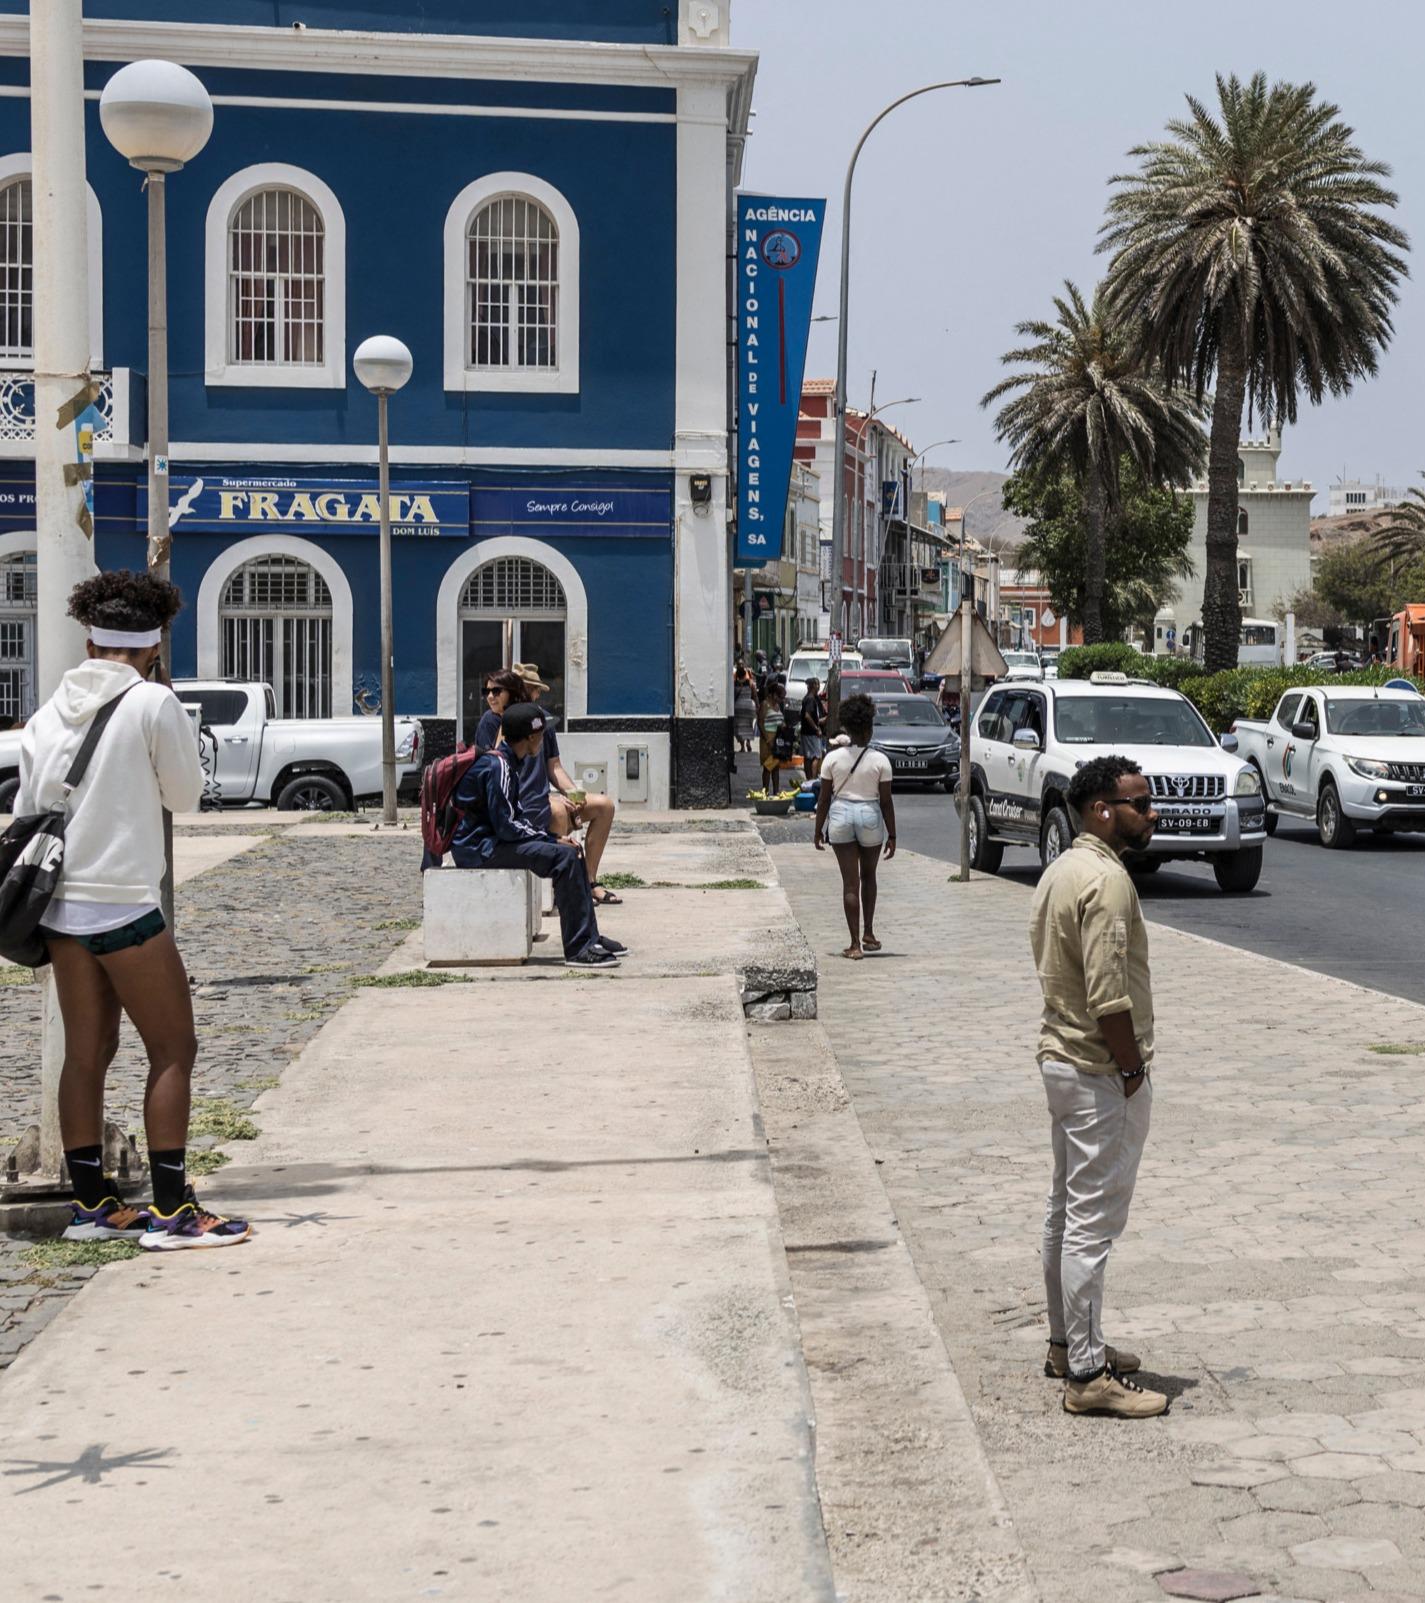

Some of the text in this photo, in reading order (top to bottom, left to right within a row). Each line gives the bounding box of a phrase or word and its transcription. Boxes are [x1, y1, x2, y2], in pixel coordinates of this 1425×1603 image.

[745, 206, 816, 222] AGÊNCIA
[745, 229, 759, 364] NACIONAL
[748, 372, 758, 394] DE
[222, 478, 297, 489] Supermercado
[19, 494, 37, 503] PR
[219, 491, 439, 523] FRAGATA
[527, 500, 567, 515] Sempre
[392, 526, 440, 536] DOM LUÍS
[748, 533, 766, 545] SA
